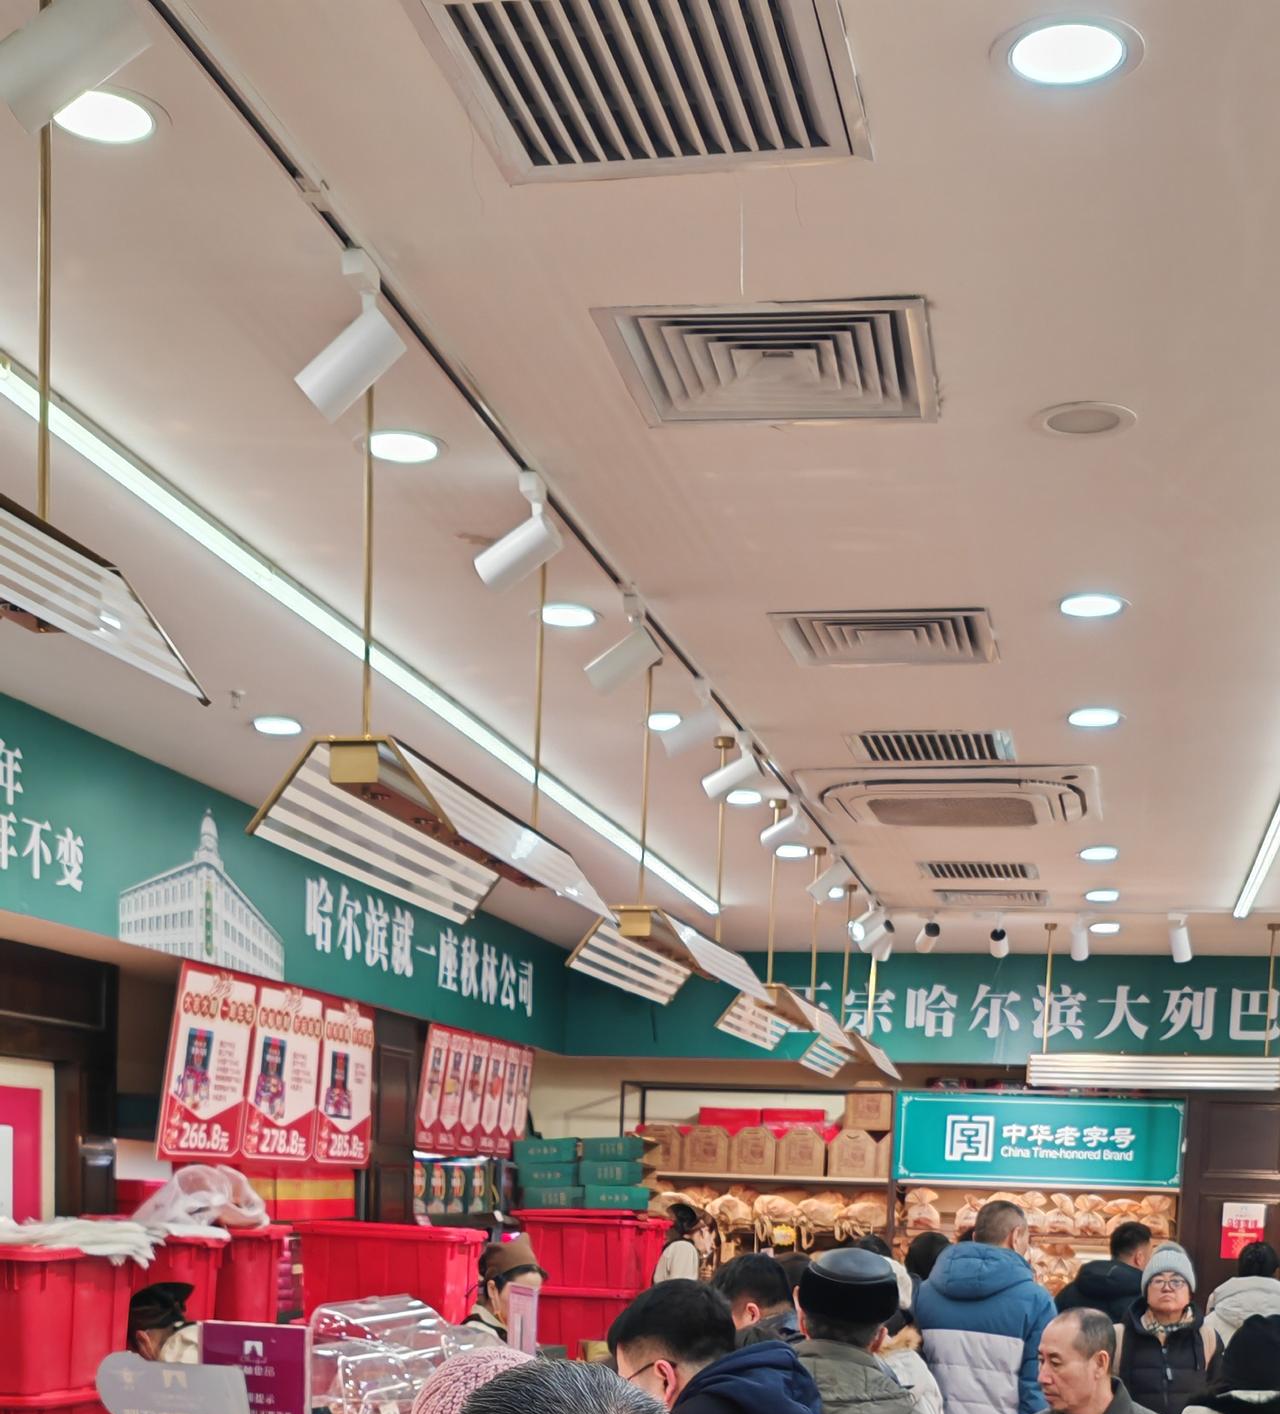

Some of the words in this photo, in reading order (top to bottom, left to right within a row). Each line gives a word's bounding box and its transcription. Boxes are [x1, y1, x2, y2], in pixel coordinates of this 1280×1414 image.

[306, 876, 533, 1017] 哈尔滨就一座秋林公司
[1001, 1124, 1136, 1148] 中华老字号
[1000, 1145, 1031, 1158] China
[1032, 1147, 1101, 1161] Time-honored
[1102, 1149, 1134, 1162] Brand
